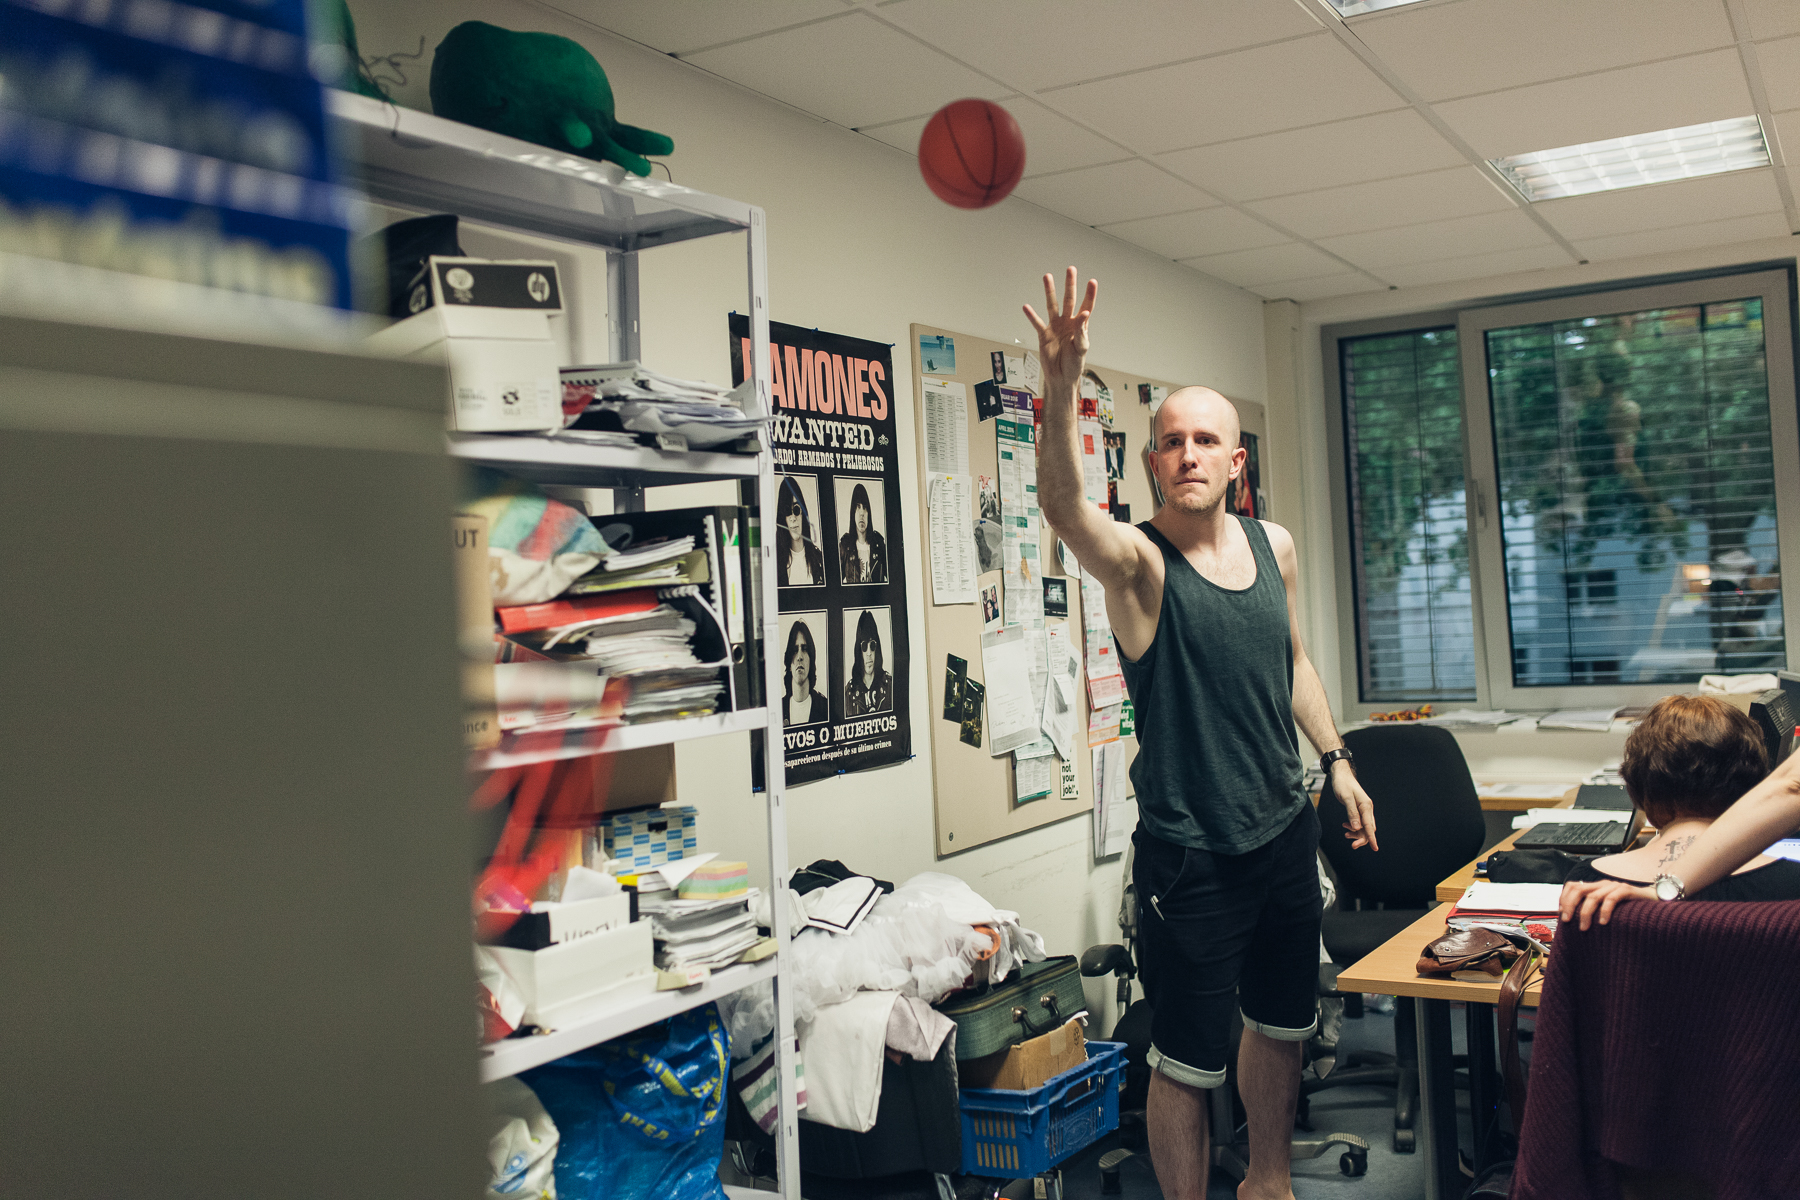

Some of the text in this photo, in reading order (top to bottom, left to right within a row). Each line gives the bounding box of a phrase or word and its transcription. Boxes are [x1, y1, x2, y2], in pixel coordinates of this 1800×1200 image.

[772, 415, 874, 451] WANTED
[798, 450, 835, 468] ARMADOS
[836, 452, 841, 469] Y
[842, 453, 885, 472] PELIGROSOS
[819, 727, 830, 744] O
[833, 715, 898, 742] MUERTOS
[784, 740, 892, 769] saparecieron después de su último crimen
[1061, 763, 1072, 773] not
[1061, 774, 1075, 785] your
